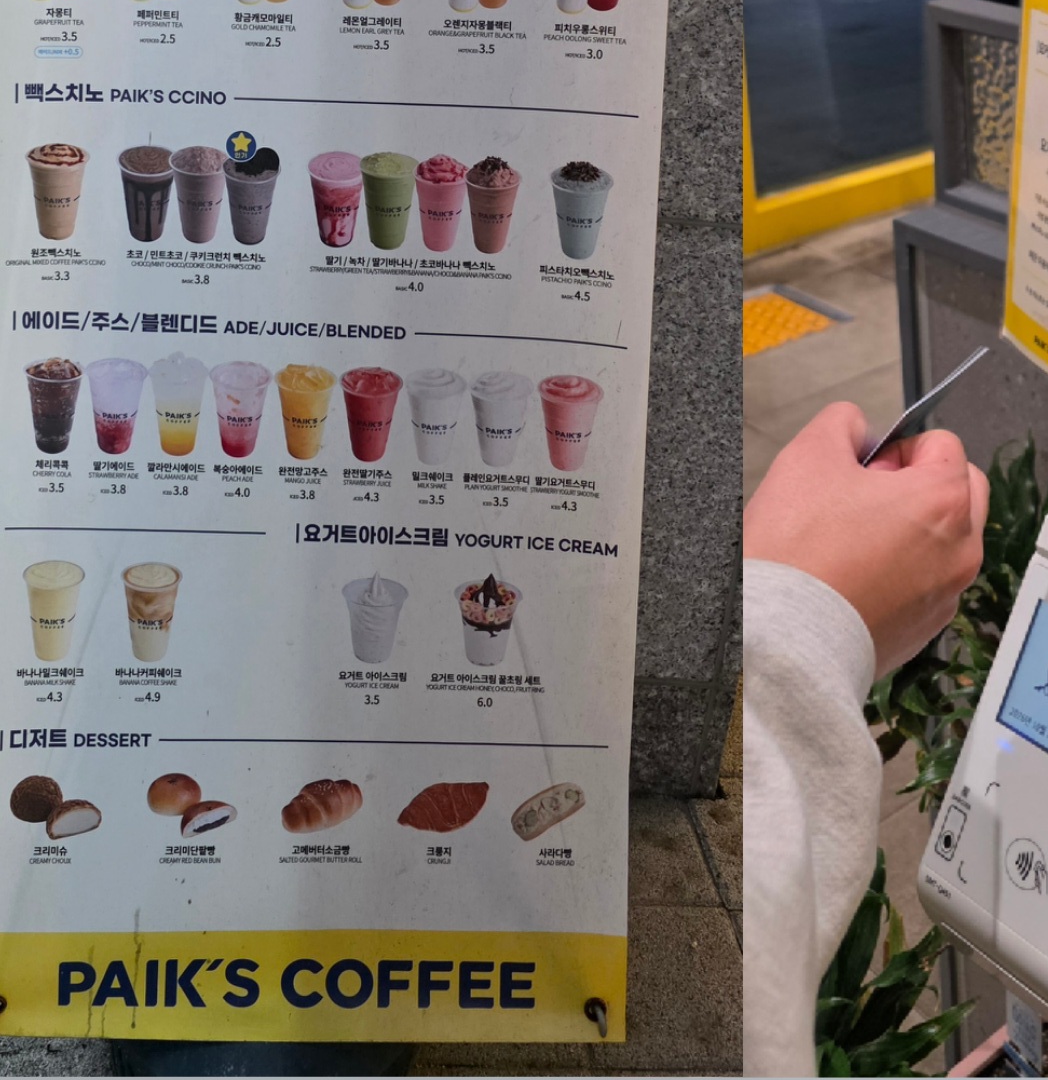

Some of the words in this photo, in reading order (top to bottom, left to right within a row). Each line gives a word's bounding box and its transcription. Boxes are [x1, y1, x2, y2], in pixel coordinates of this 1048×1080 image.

[46, 8, 72, 18] 자몽티
[343, 16, 402, 28] 레몬얼그레이티
[555, 23, 616, 37] 피치우롱스위티
[25, 83, 103, 103] 빽스치노
[111, 89, 164, 104] PAIK'S
[169, 90, 226, 105] CCINO
[574, 291, 590, 302] 4.5
[22, 310, 218, 335] 에이드/주스/블렌디드
[224, 321, 406, 340] ADE/JUICE/BLENDED
[35, 460, 69, 470] 체리콕콕
[214, 464, 263, 475] 복숭아에이드
[412, 472, 453, 482] 밀크쉐이크
[173, 486, 188, 496] 3.8
[561, 501, 577, 512] 4.3
[304, 524, 448, 547] 요거트아이스크림
[455, 533, 523, 549] YOGURT
[527, 536, 554, 551] ICE
[558, 539, 618, 557] CREAM
[145, 692, 160, 702] 4.9
[477, 697, 492, 708] 6.0
[10, 729, 66, 748] 디저트
[74, 734, 151, 747] DESSERT
[33, 846, 68, 856] 크리미슈
[165, 845, 216, 856] 크리미단팥빵
[58, 958, 259, 1009] PAIK'S
[281, 958, 535, 1009] COFFEE
